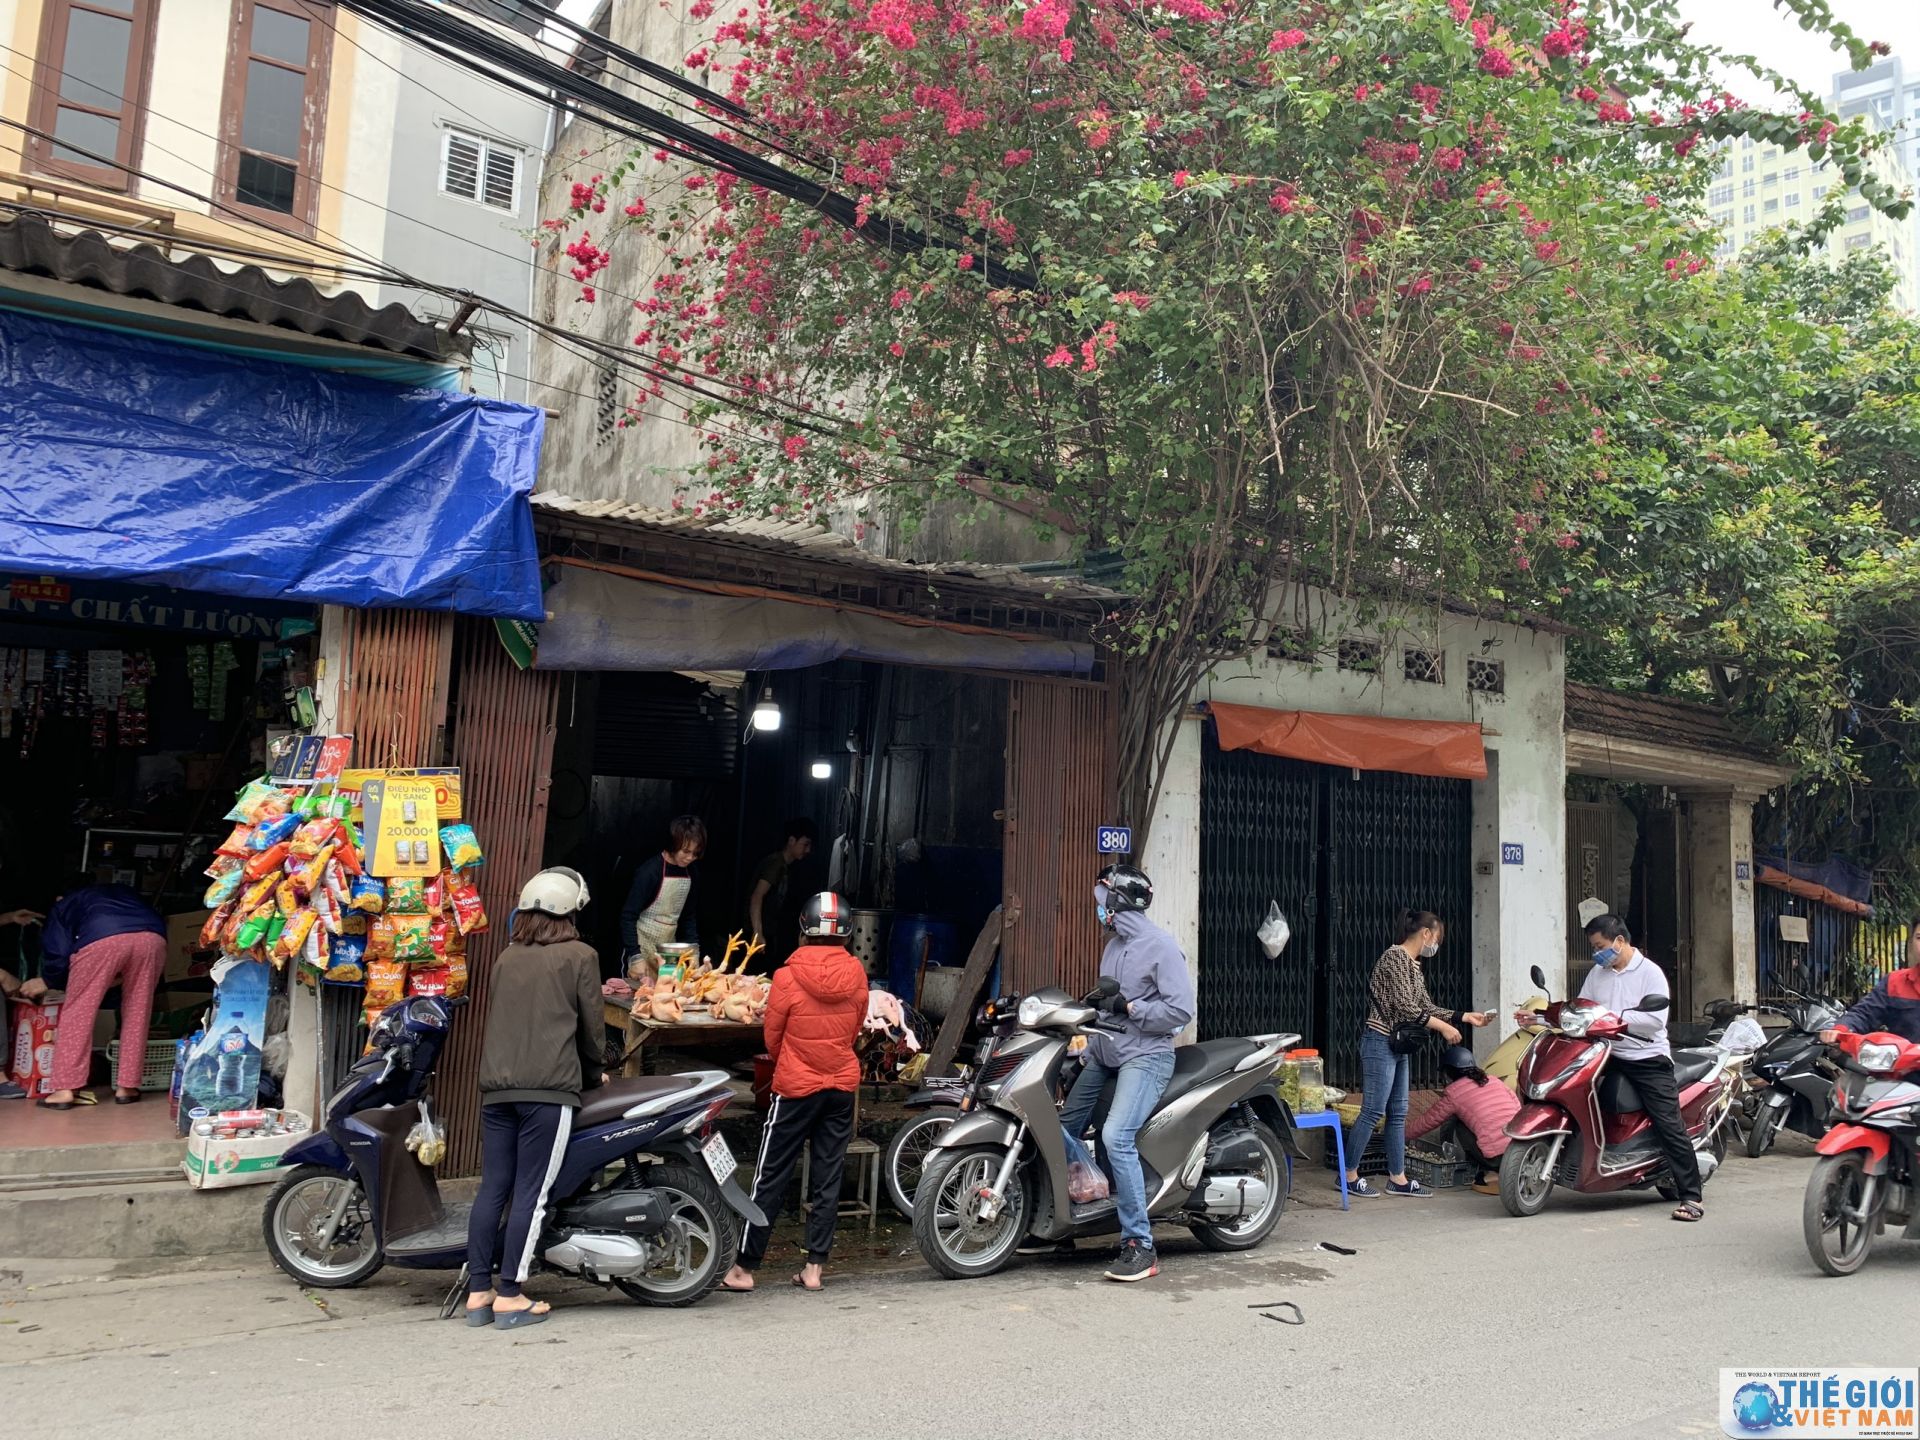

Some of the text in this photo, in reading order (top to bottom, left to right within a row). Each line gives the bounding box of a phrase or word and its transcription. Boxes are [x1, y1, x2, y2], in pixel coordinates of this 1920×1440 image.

[71, 595, 173, 627] CHẤT
[182, 608, 283, 638] LƯỢN
[1102, 831, 1128, 849] 380
[1504, 846, 1522, 861] 378
[601, 1120, 659, 1142] VISION
